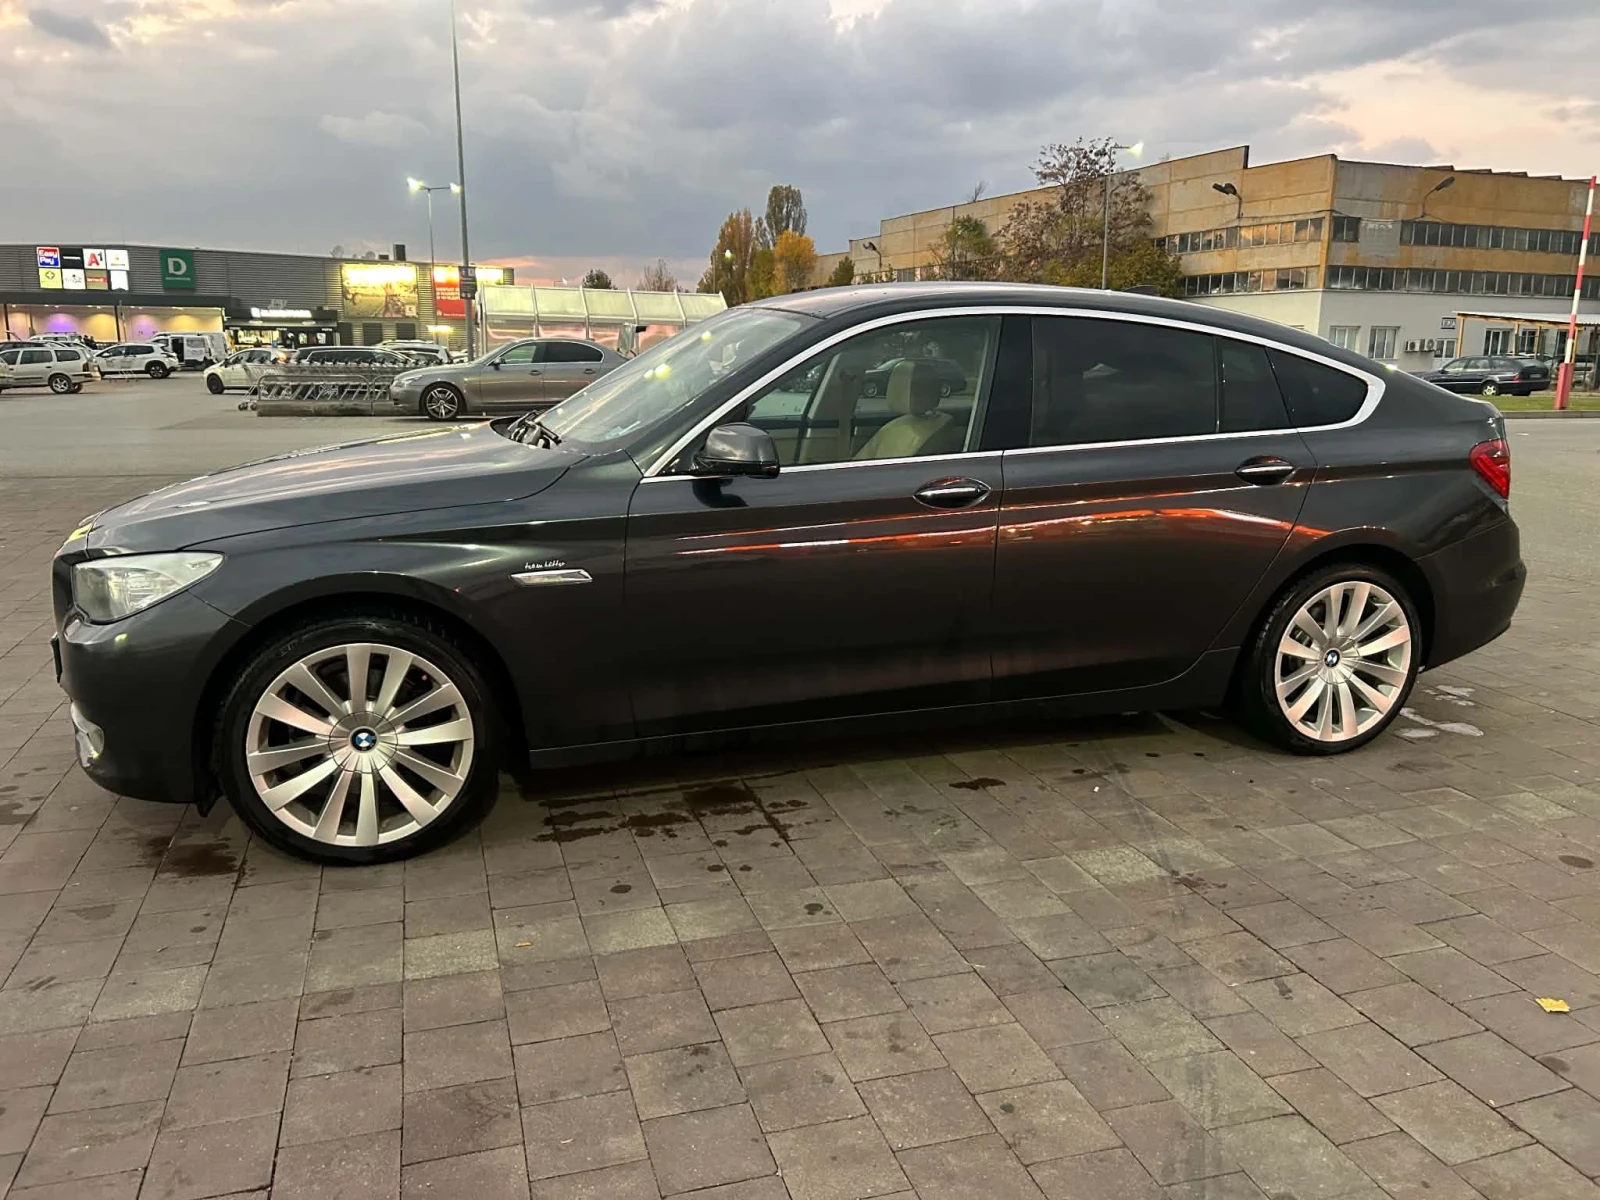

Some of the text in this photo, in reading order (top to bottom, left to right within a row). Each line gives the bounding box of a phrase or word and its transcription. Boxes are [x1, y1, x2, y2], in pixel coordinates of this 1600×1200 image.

[39, 249, 57, 258] Easy
[87, 252, 103, 266] A1
[40, 257, 54, 265] Pay
[168, 258, 187, 275] D
